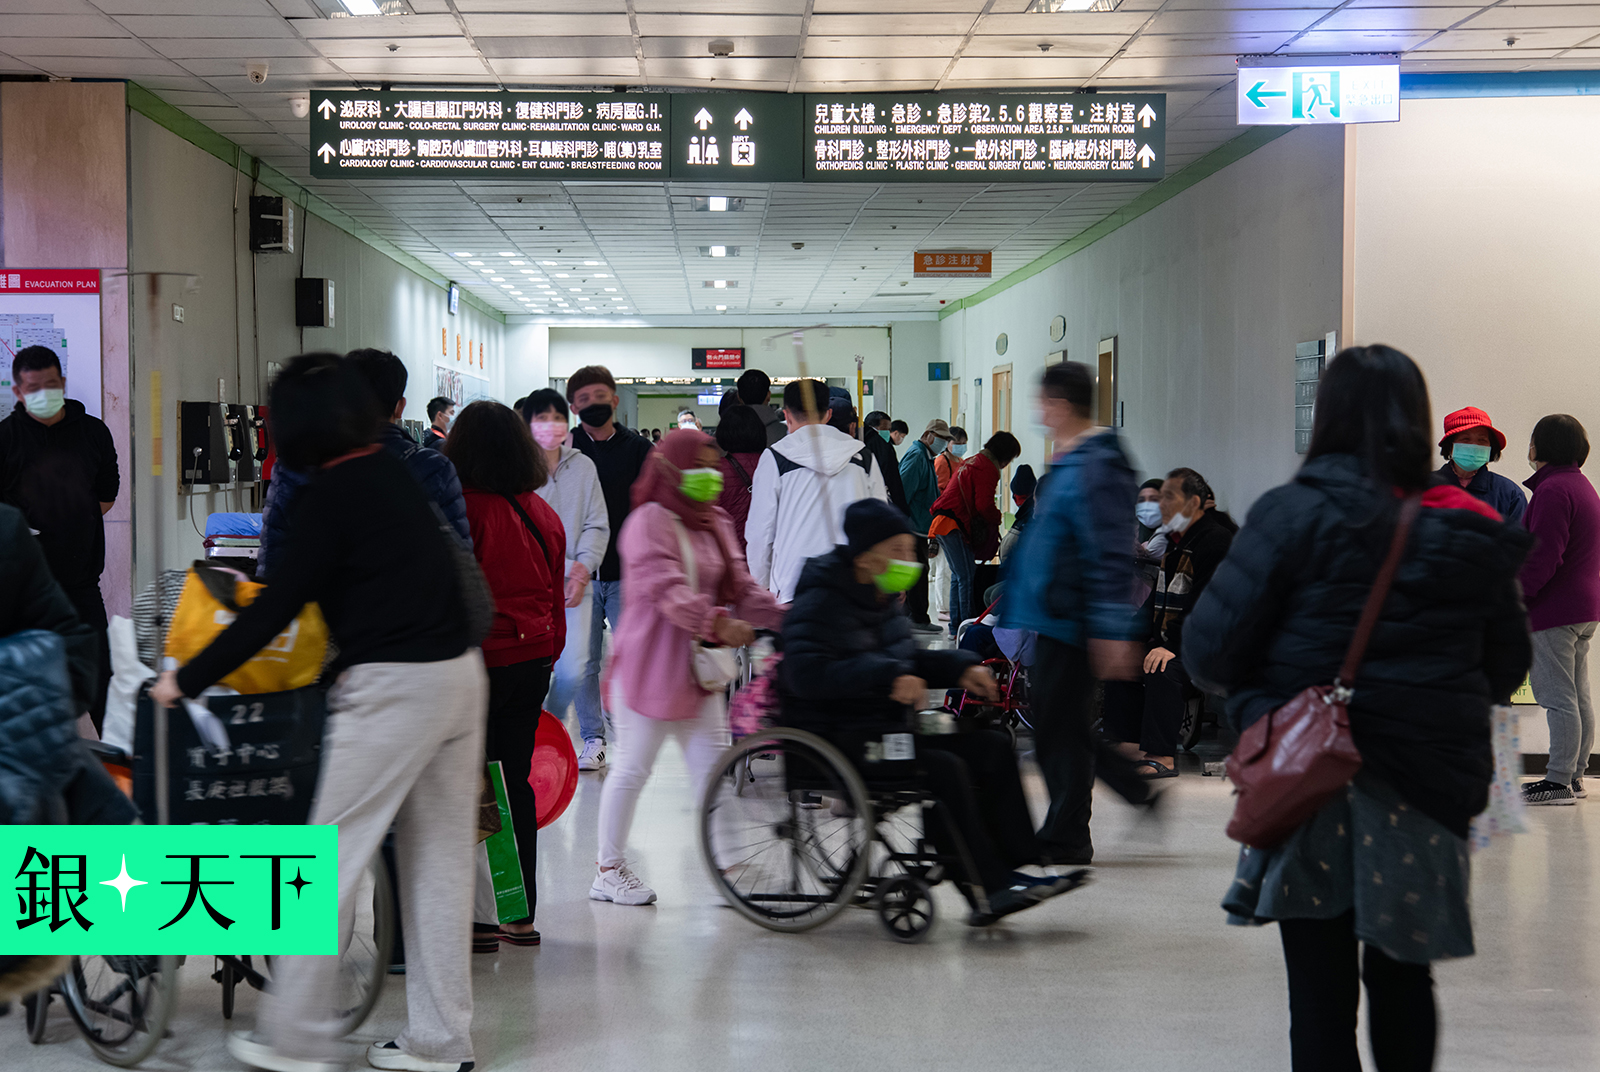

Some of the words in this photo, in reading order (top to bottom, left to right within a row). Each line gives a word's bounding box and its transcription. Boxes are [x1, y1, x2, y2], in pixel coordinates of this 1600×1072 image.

[1352, 79, 1385, 91] EXIT
[1345, 93, 1393, 107] 緊急出口
[340, 100, 382, 119] 泌尿科
[394, 101, 504, 120] 大腸直腸肛門外科
[515, 102, 584, 120] 復健科門診
[815, 102, 876, 124] 兒童大樓
[891, 102, 922, 124] 急診
[1090, 102, 1136, 124] 注射室
[340, 121, 376, 130] UROLOGY
[379, 121, 404, 130] CLINIC
[409, 121, 461, 131] COLO-RECTAL
[463, 122, 499, 131] SURGERY
[502, 122, 526, 131] CLINIC
[530, 122, 589, 132] REHABILITATION
[592, 123, 617, 132] CLINIC
[621, 123, 643, 132] WARD
[646, 123, 662, 132] G.H.
[814, 124, 850, 135] CHILDREN
[853, 124, 887, 135] BUILDING
[896, 124, 941, 135] EMERGENCY
[943, 124, 963, 135] DEPT
[971, 124, 1022, 135] OBSERVATION
[1024, 124, 1044, 135] AREA
[1046, 124, 1063, 135] 2.5.6
[1072, 124, 1110, 135] INJECTION
[1112, 124, 1135, 134] ROOM
[732, 135, 749, 143] MRT
[340, 138, 411, 158] 心臟內科門診
[417, 139, 522, 159] 胸腔及心臟血管外科
[528, 140, 598, 159] 耳鼻喉科門診
[814, 138, 865, 160] 骨科門診
[877, 138, 951, 160] 整形外科門診
[962, 138, 1037, 160] 一般外科門診
[1049, 138, 1137, 160] 腦神經外科門診
[340, 159, 388, 168] CARDIOLOGY
[390, 159, 415, 168] CLINIC
[420, 160, 488, 169] CARDIOVASCULAR
[490, 160, 515, 169] CLINIC
[522, 160, 537, 169] ENT
[540, 160, 564, 169] CLINIC
[571, 161, 635, 170] BREASTFEEDING
[638, 161, 662, 170] ROOM
[815, 160, 863, 171] ORTHOPEDICS
[866, 160, 888, 171] CLINIC
[896, 160, 924, 171] PLASTIC
[926, 160, 948, 171] CLINIC
[955, 160, 987, 171] GENERAL
[989, 160, 1021, 171] SURGERY
[1023, 160, 1045, 171] CLINIC
[1054, 160, 1109, 171] NEUROSURGERY
[1111, 160, 1134, 171] CLINIC
[923, 254, 984, 266] 急診注射室
[24, 280, 73, 289] EVACUATION
[76, 280, 96, 288] PLAN
[229, 701, 265, 725] 22
